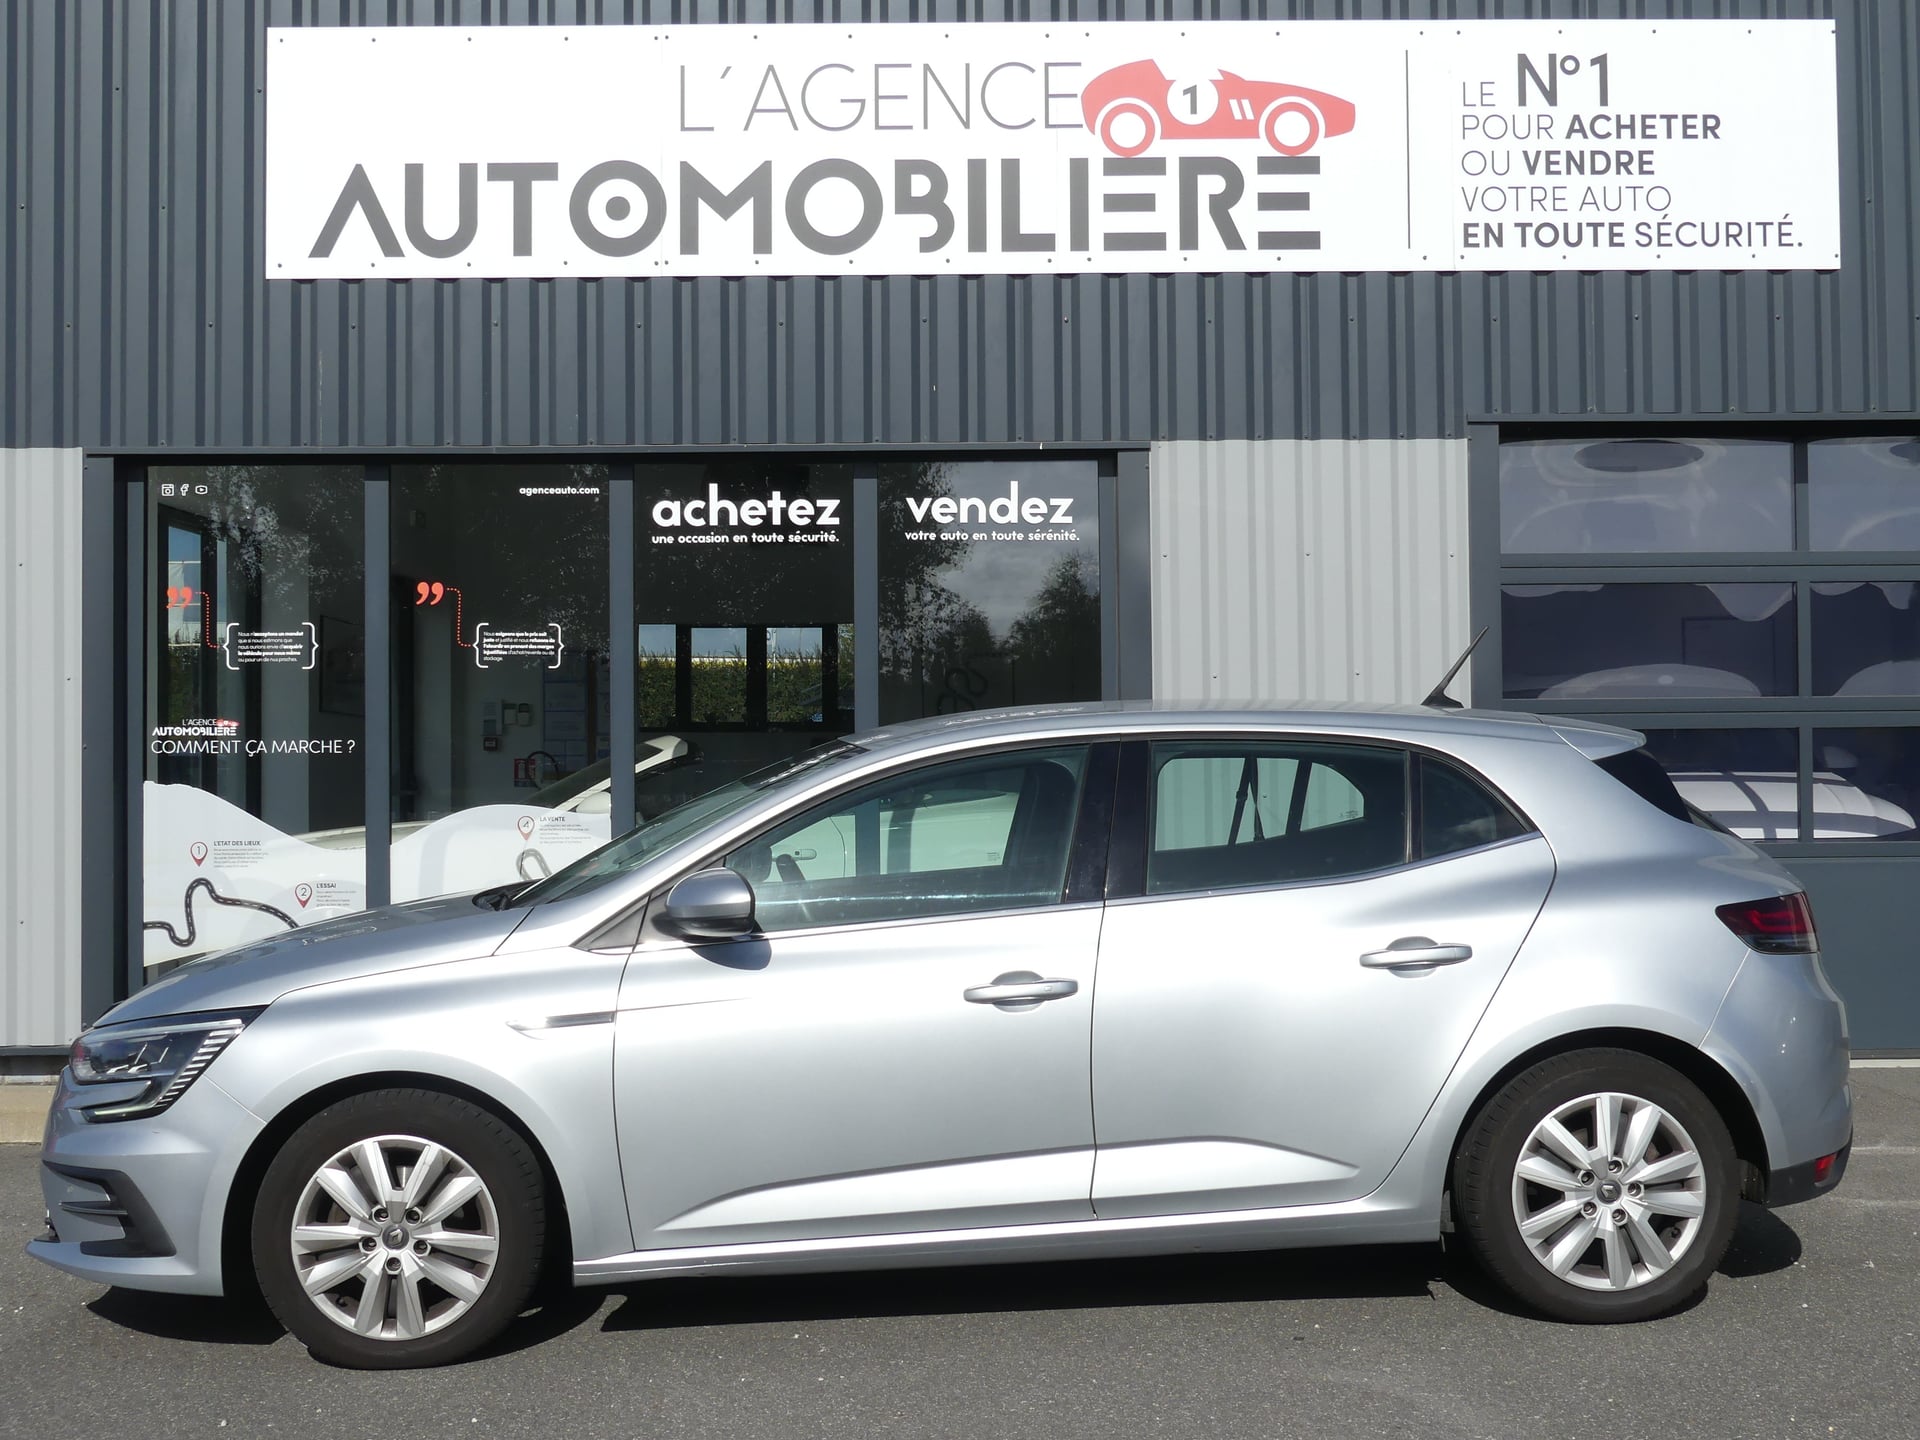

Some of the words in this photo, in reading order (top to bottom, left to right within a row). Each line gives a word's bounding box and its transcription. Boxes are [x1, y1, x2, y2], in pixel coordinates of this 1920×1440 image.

[1182, 84, 1198, 115] 1
[1462, 81, 1497, 107] LE
[1462, 114, 1554, 140] POUR
[1565, 114, 1721, 140] ACHETER
[1461, 150, 1510, 176] OU
[1521, 150, 1656, 176] VENDRE
[307, 155, 1321, 259] AUTOMOBILIERE
[1461, 186, 1569, 212] VOTRE
[1579, 186, 1672, 212] AUTO
[1463, 222, 1504, 248] EN
[1514, 221, 1626, 248] TOUTE
[1634, 213, 1803, 248] SÉCURITÉ.
[519, 485, 600, 496] agenceauto.com
[905, 480, 1075, 525] vendez
[651, 483, 841, 527] achetez
[652, 534, 675, 545] une
[677, 531, 729, 544] occasion
[732, 534, 748, 544] en
[751, 532, 784, 543] toute
[788, 530, 840, 544] sécurité.
[904, 530, 937, 542] votre
[940, 530, 969, 542] auto
[972, 531, 988, 541] en
[991, 530, 1024, 541] toute
[1027, 529, 1080, 542] sérénité.
[151, 727, 237, 736] AUTOMOBILIERE
[182, 718, 217, 727] L'AGENCE
[151, 740, 241, 754] COMMENT
[245, 739, 268, 757] ÇA
[271, 740, 343, 754] MARCHE
[300, 887, 307, 896] 2
